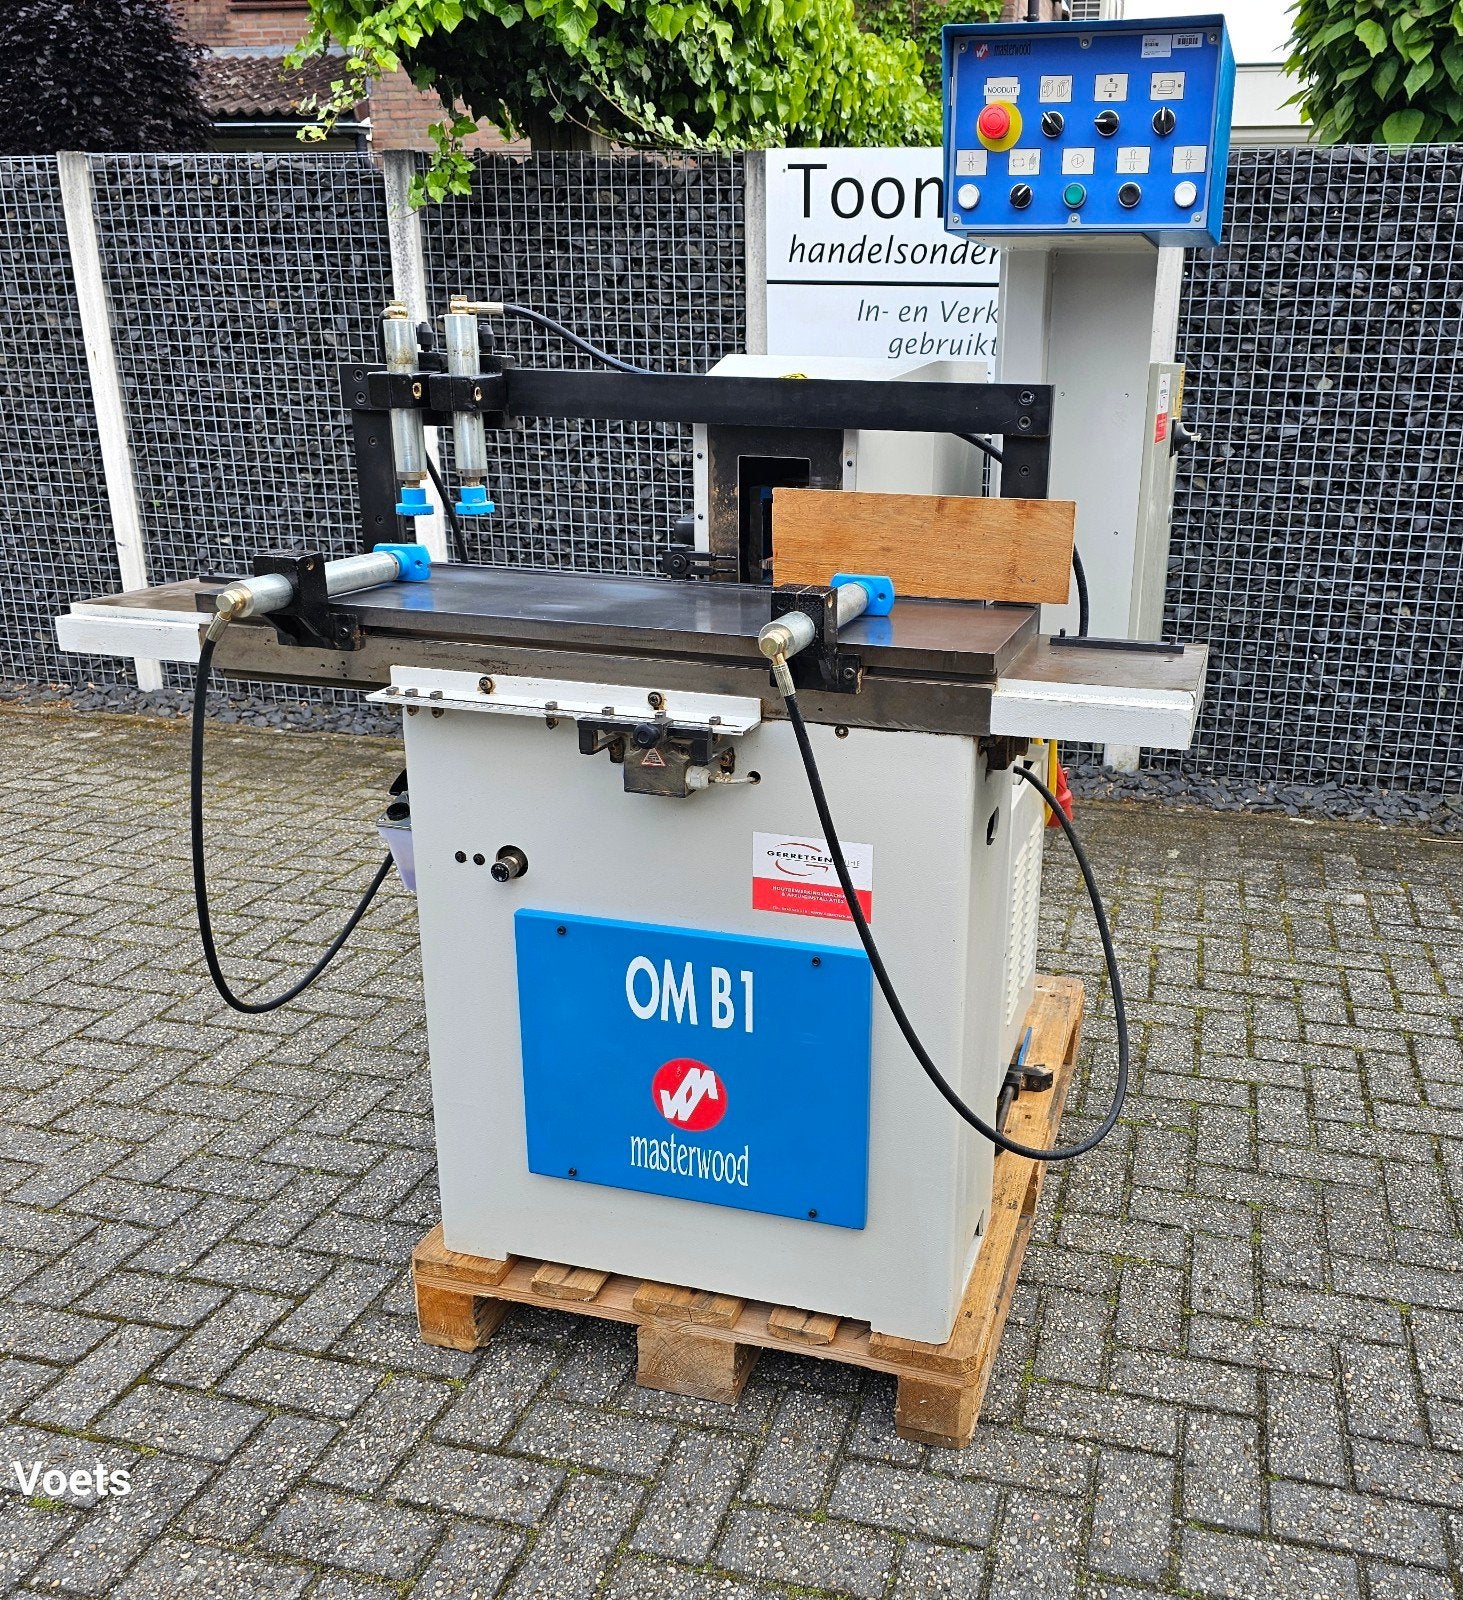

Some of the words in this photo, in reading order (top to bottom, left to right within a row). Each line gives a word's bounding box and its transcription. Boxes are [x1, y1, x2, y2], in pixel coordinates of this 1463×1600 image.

[987, 86, 1017, 94] NOODUIT
[788, 164, 944, 219] Toon
[858, 300, 889, 322] In-
[898, 304, 928, 323] en
[941, 300, 998, 323] Verk
[625, 955, 699, 1025] OM
[711, 966, 754, 1033] B1
[630, 1133, 749, 1187] masterwood
